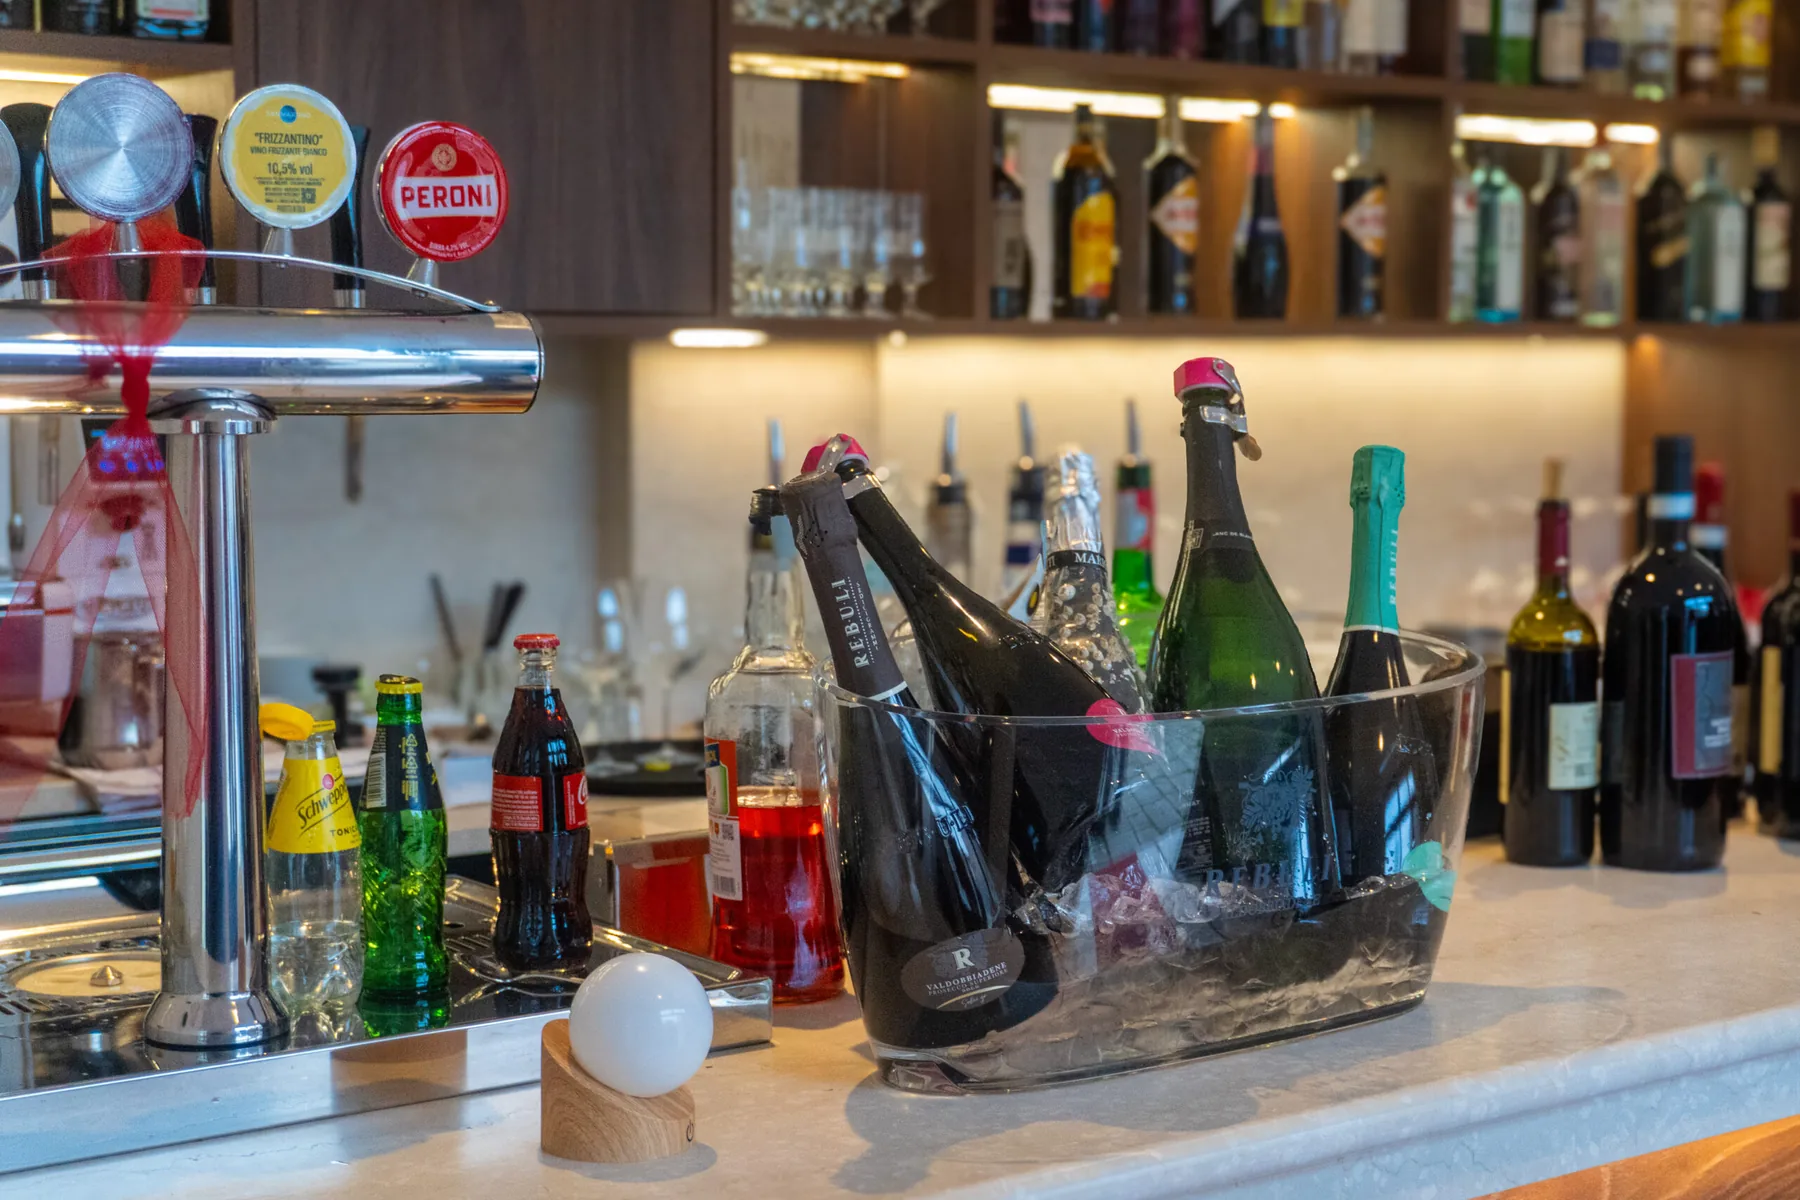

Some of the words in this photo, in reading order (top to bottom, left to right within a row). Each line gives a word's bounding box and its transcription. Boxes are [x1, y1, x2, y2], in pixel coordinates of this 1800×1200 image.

[254, 132, 323, 146] "FRIZZANTINO"
[250, 146, 268, 155] VINO
[268, 147, 301, 156] FRIZZANTE
[302, 147, 328, 157] BIANCO
[267, 162, 297, 176] 10,5%
[299, 163, 313, 175] vol
[400, 184, 492, 209] PERONI
[952, 948, 976, 971] R
[926, 961, 1008, 991] VALDOBBIADENE
